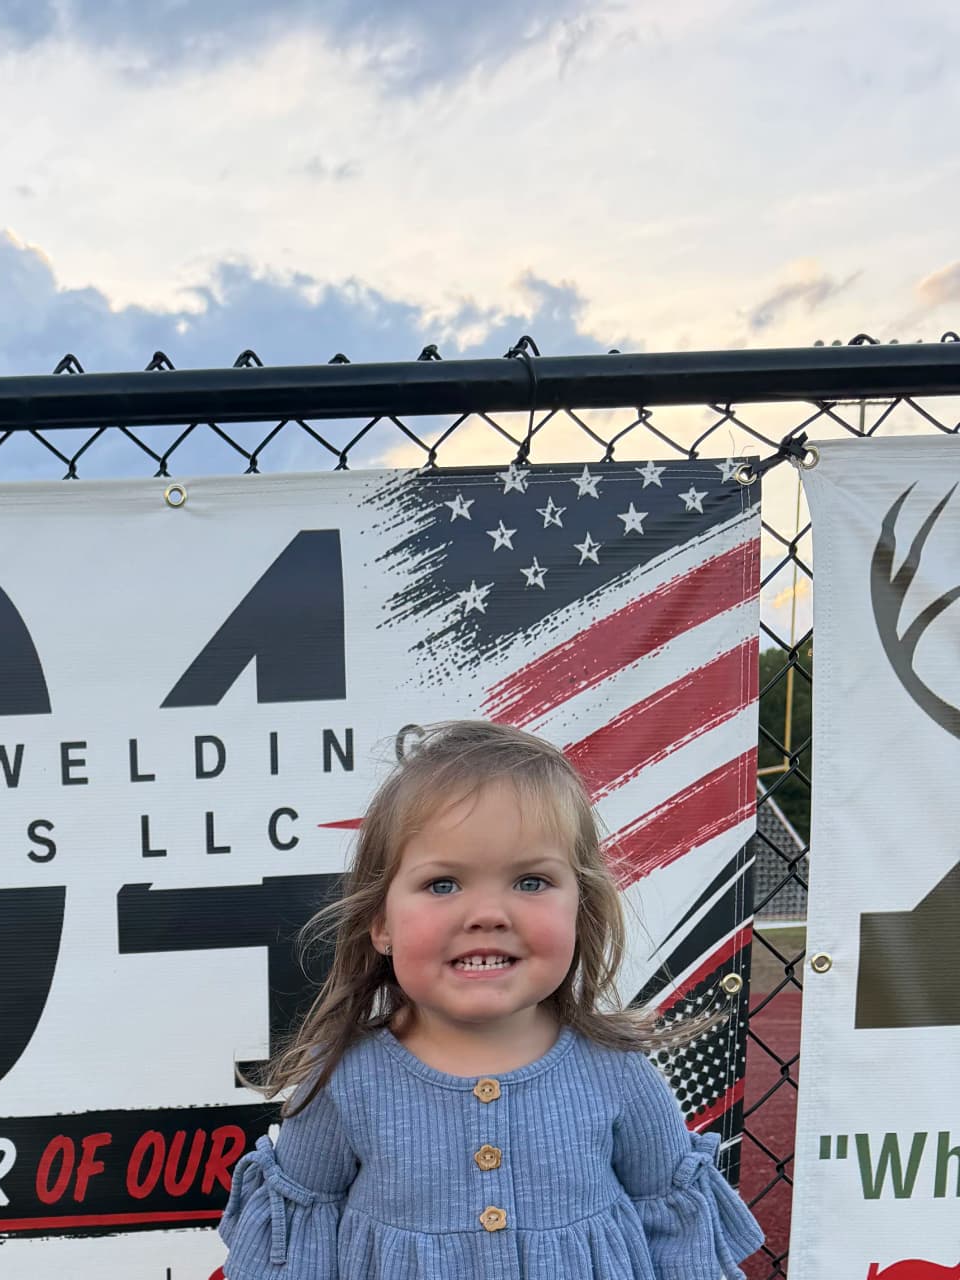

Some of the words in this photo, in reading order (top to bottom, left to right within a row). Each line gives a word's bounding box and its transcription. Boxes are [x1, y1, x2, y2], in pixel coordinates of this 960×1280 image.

[141, 807, 299, 857] LLC
[35, 1132, 112, 1205] OF
[126, 1125, 246, 1199] OUR
